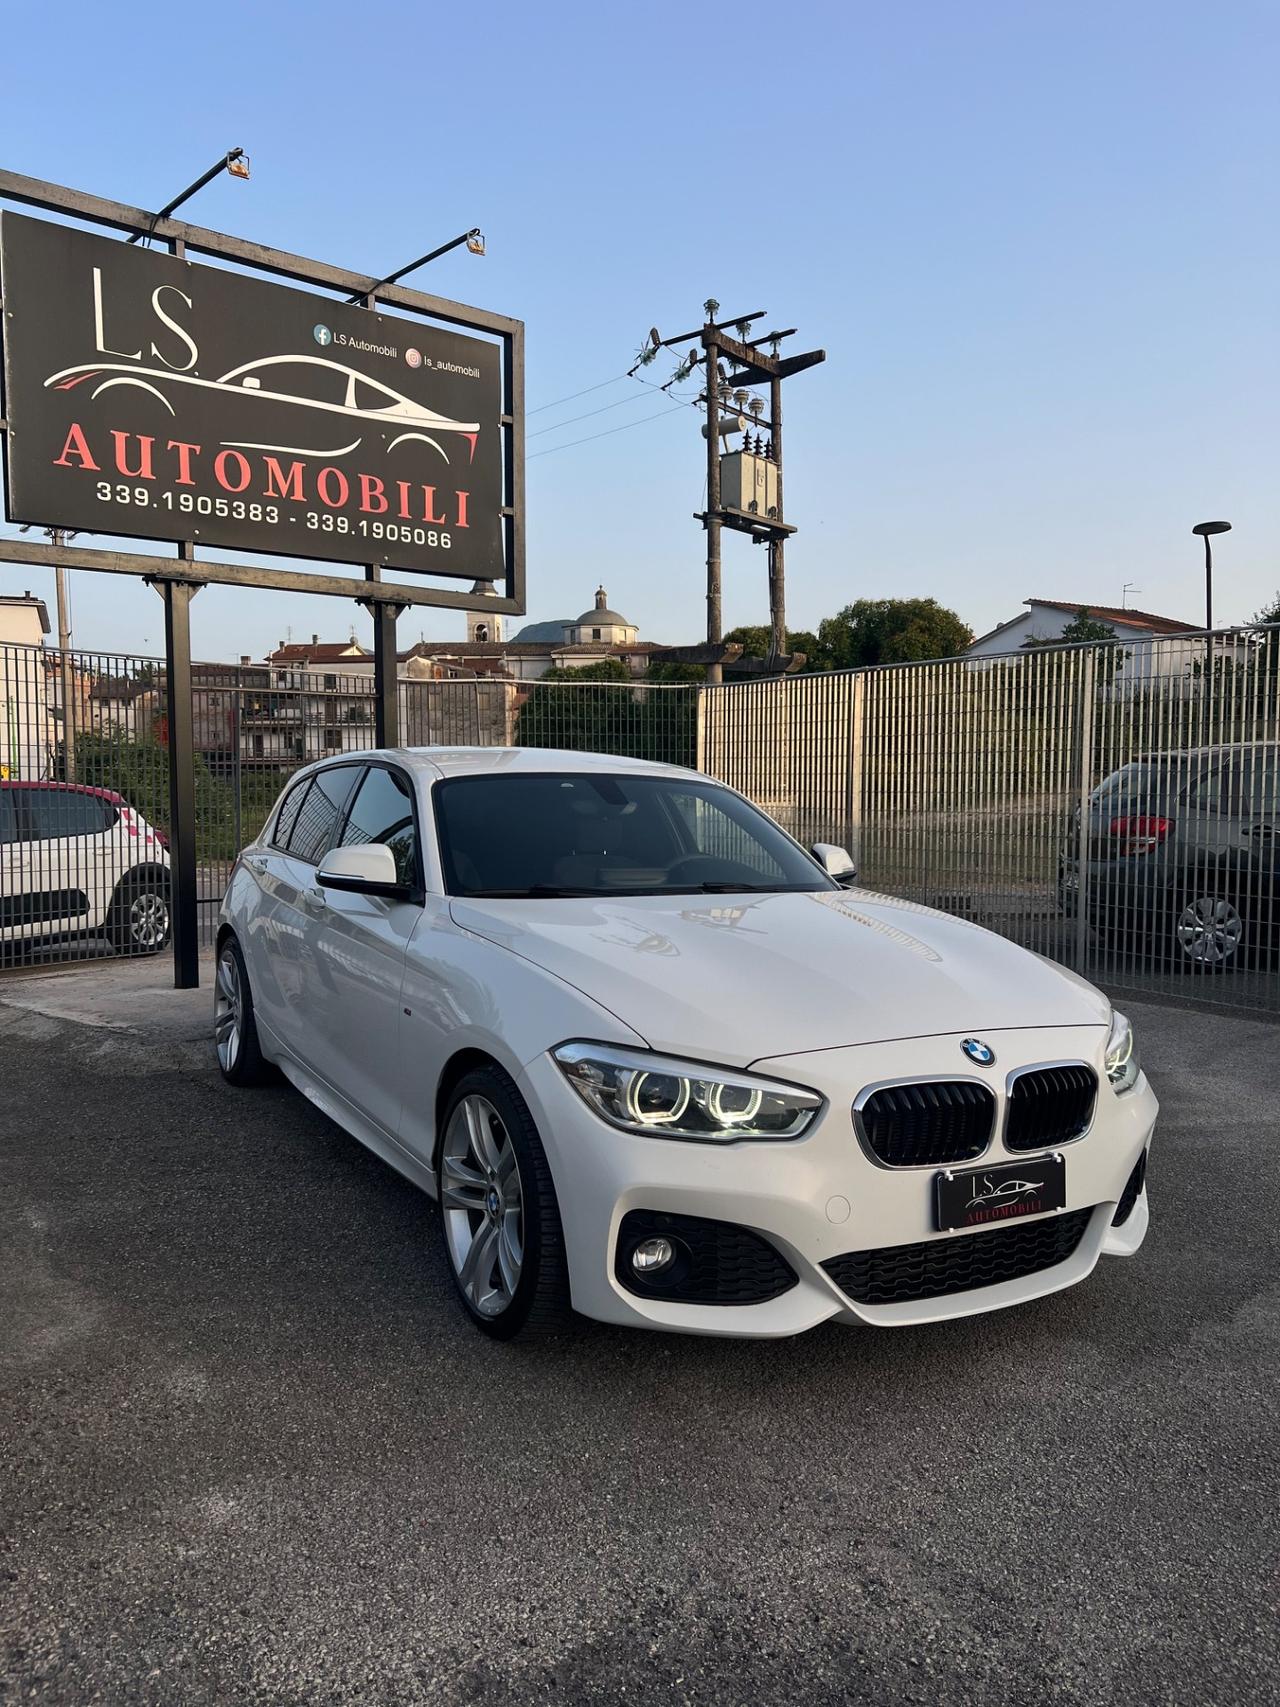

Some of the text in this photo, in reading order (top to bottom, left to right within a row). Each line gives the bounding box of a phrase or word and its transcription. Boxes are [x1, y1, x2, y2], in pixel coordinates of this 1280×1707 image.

[93, 267, 199, 371] LS
[333, 332, 347, 345] LS
[348, 336, 397, 358] Automobili
[53, 423, 470, 528] AUTOMOBILI
[96, 481, 280, 524] 339.1905383
[306, 511, 452, 549] 339.1905086
[966, 1199, 1042, 1224] AUTOMOBILI
